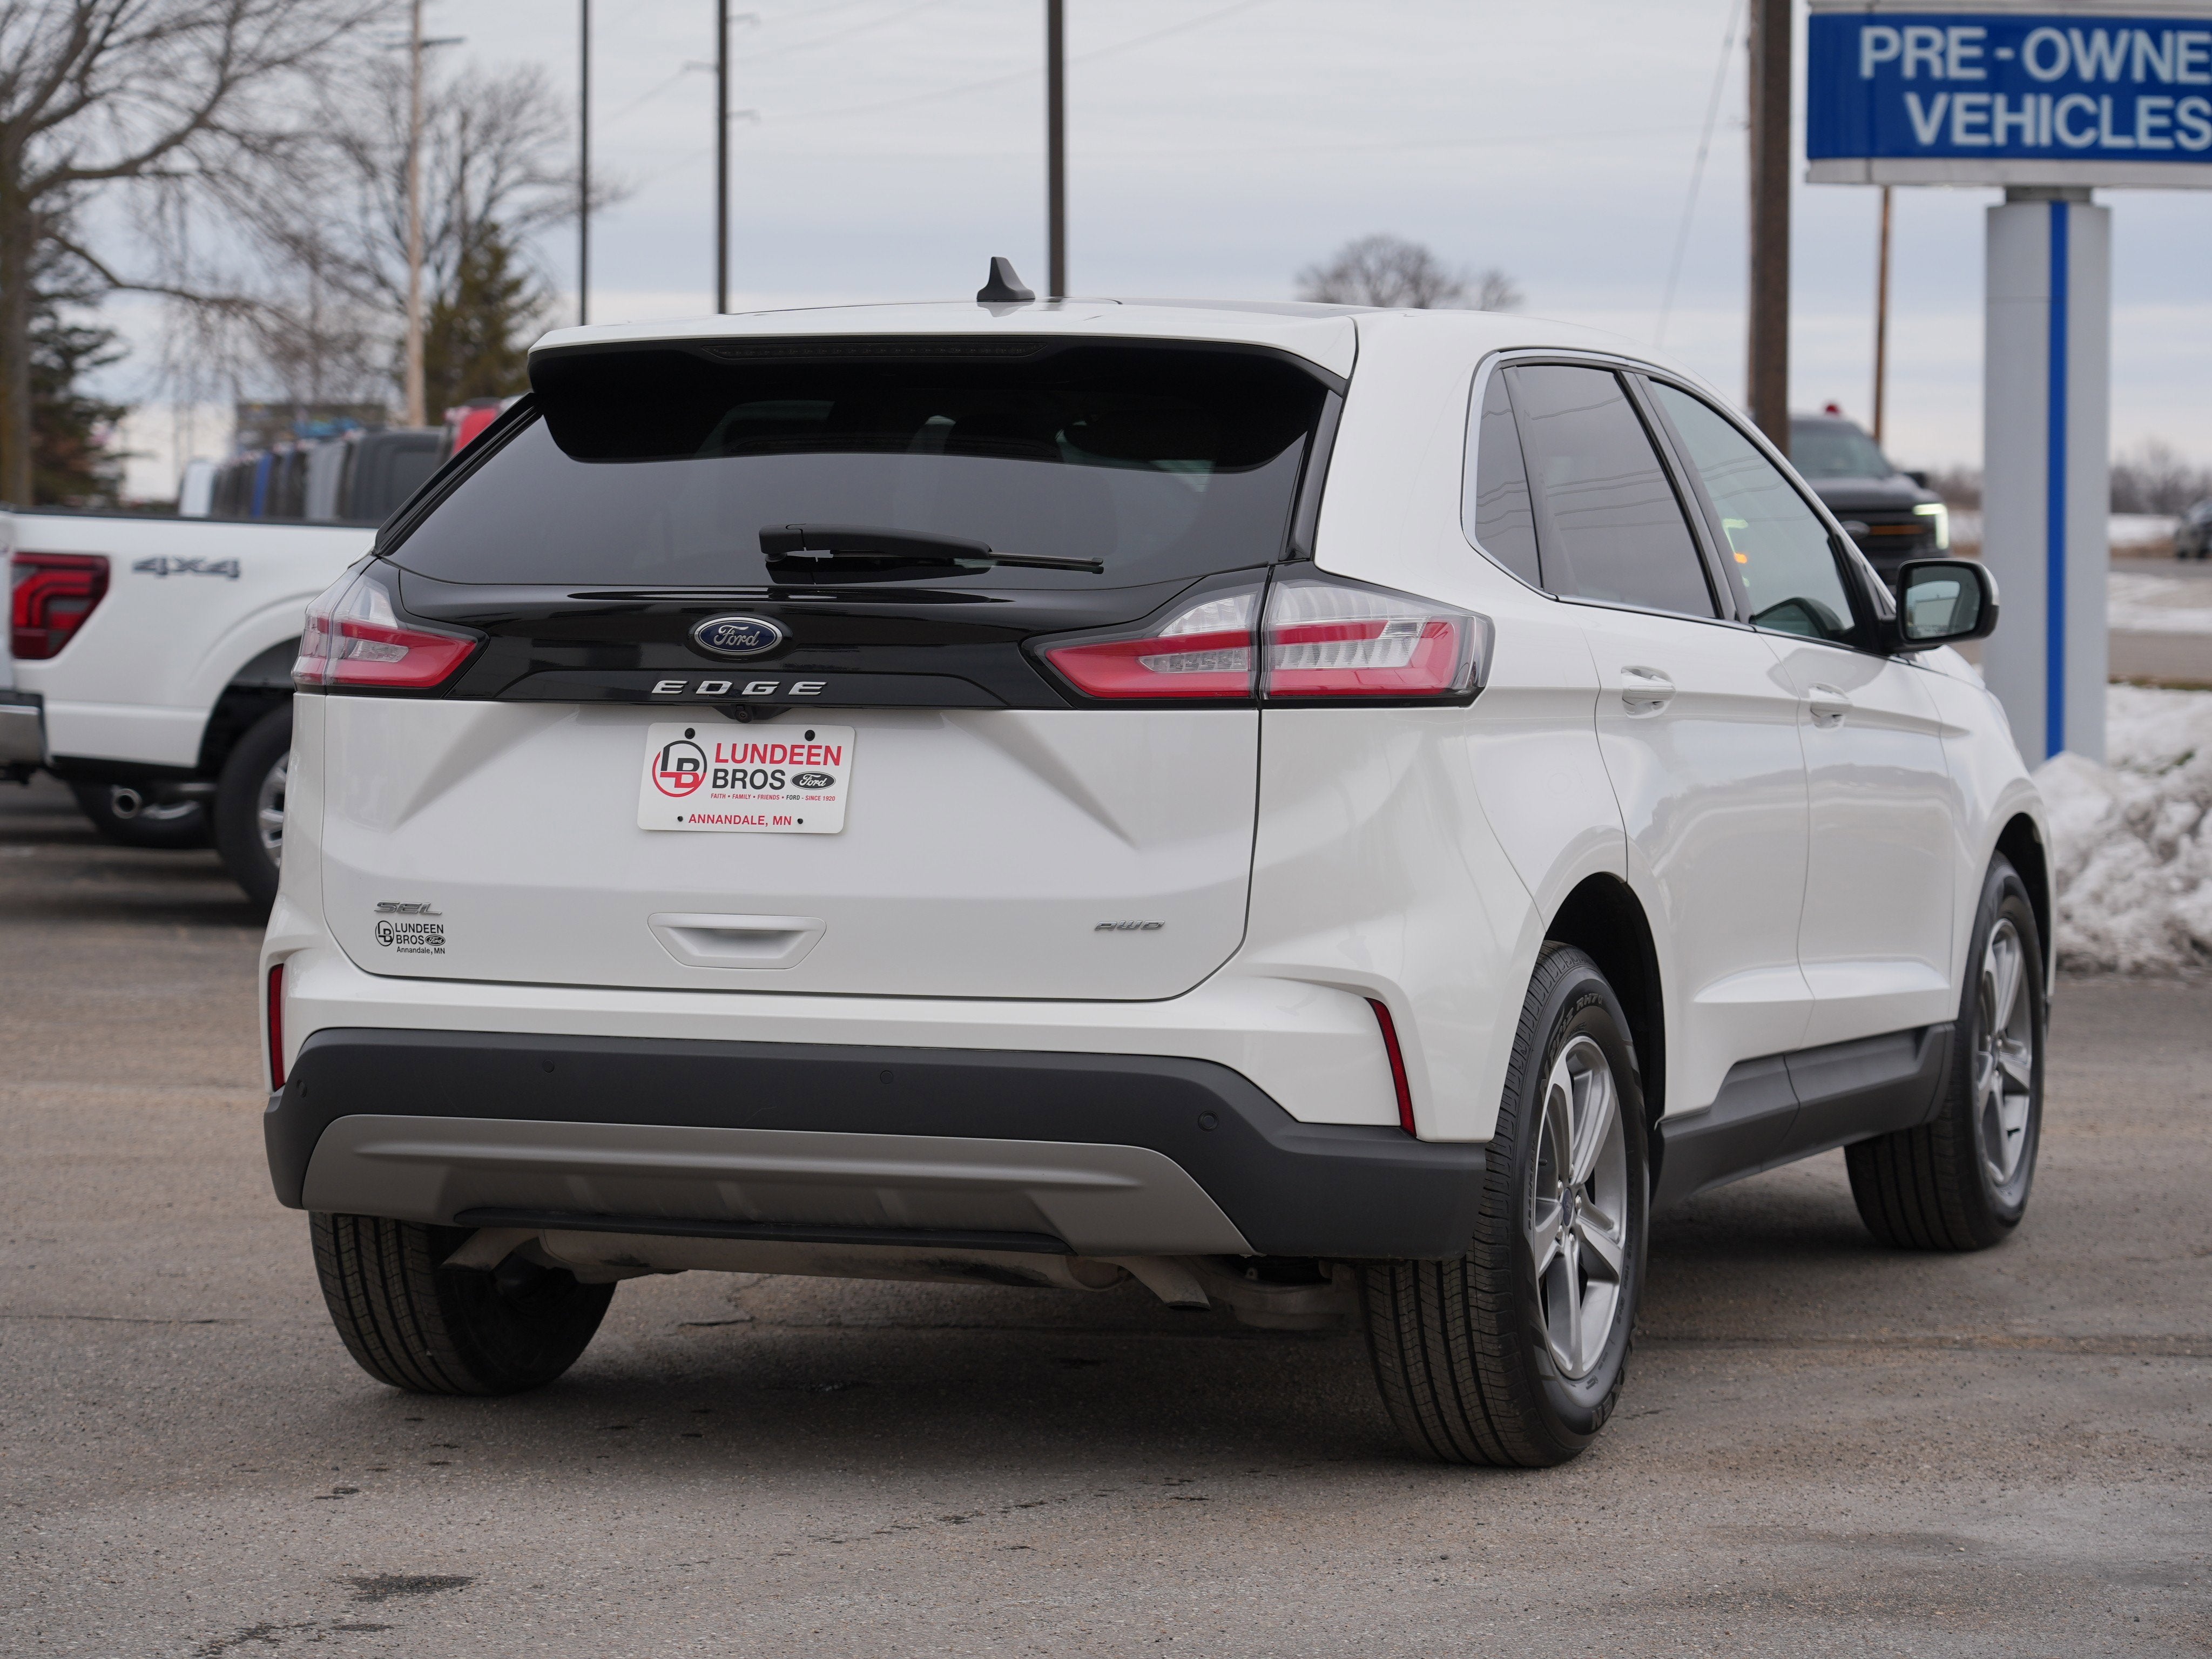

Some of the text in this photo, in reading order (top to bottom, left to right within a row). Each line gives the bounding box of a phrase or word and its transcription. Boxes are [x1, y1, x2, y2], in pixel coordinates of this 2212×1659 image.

[1904, 92, 2212, 152] VEHICLES
[713, 624, 759, 647] Ford
[651, 680, 827, 696] EDGE
[714, 743, 842, 766] LUNDEEN
[712, 768, 786, 790] BROS
[689, 814, 792, 826] ANNANDALE, MN
[374, 900, 442, 915] SEL
[395, 923, 443, 934] LUNDEEN
[1094, 920, 1165, 931] AWD
[396, 935, 424, 945] BROS
